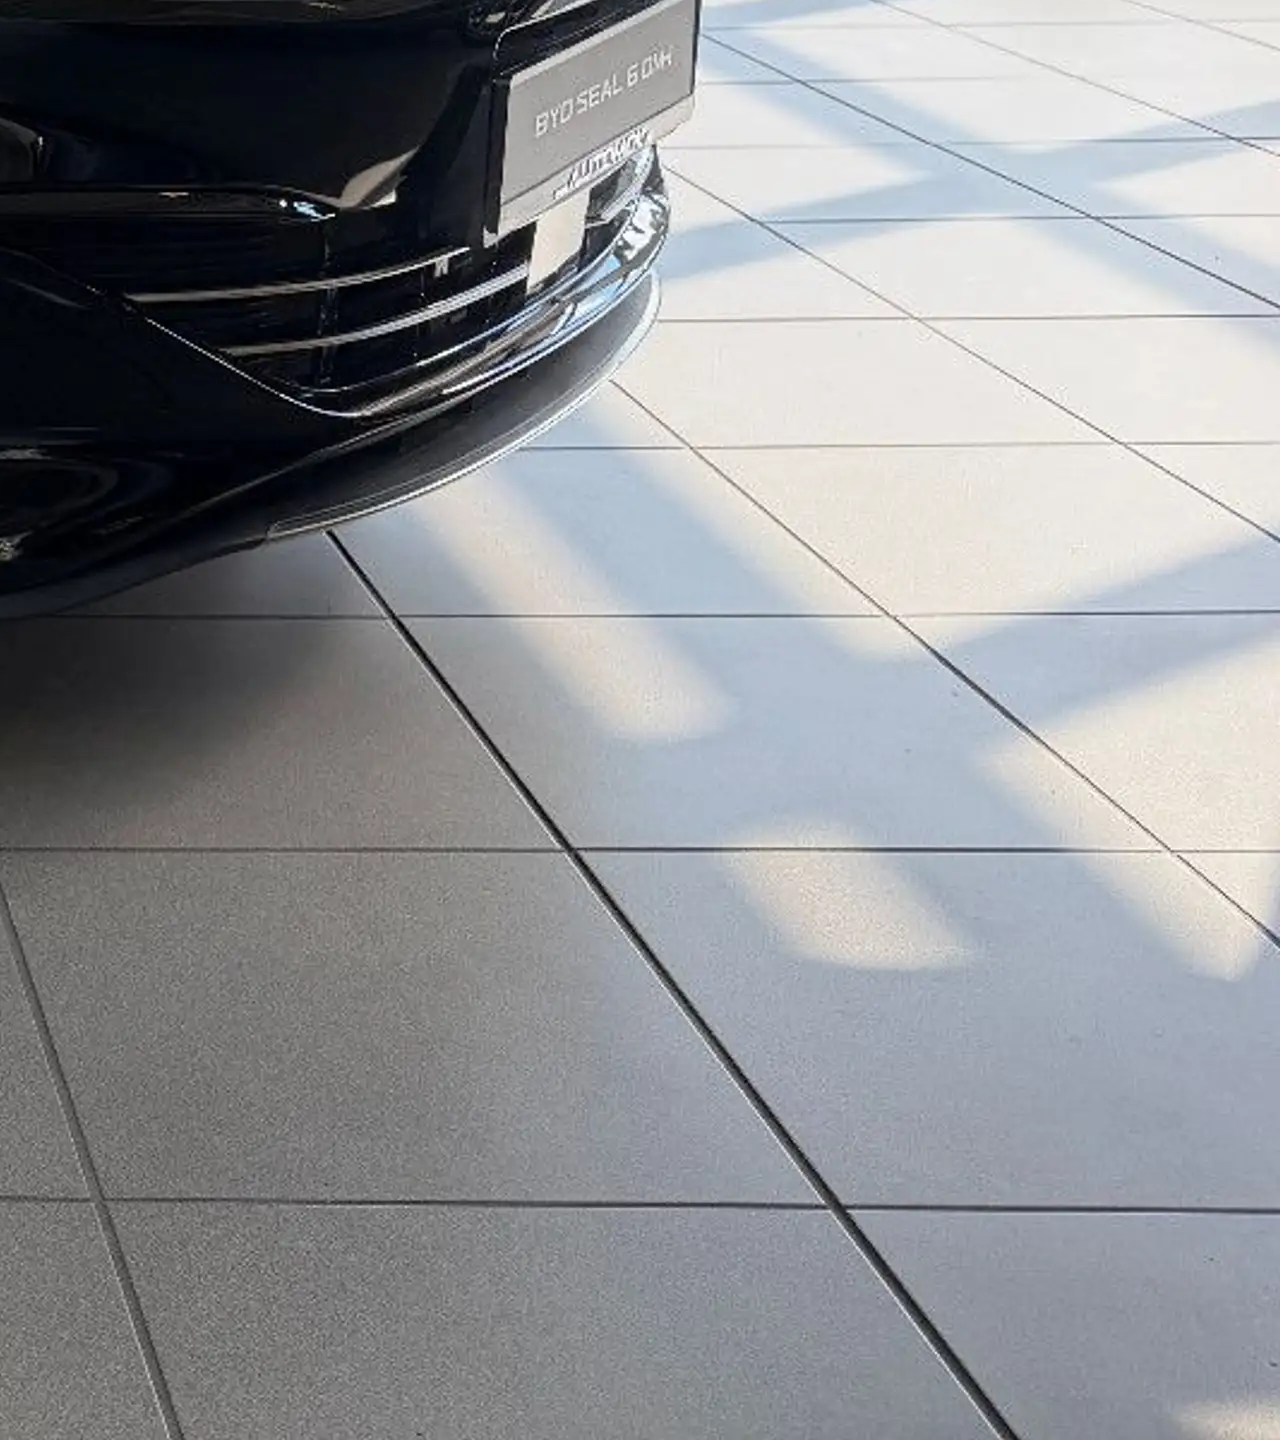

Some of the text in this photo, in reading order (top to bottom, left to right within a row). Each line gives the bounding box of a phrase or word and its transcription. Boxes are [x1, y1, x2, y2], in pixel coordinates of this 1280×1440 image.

[534, 97, 574, 138] BYD
[576, 73, 624, 115] SEAL
[627, 63, 639, 89] 6
